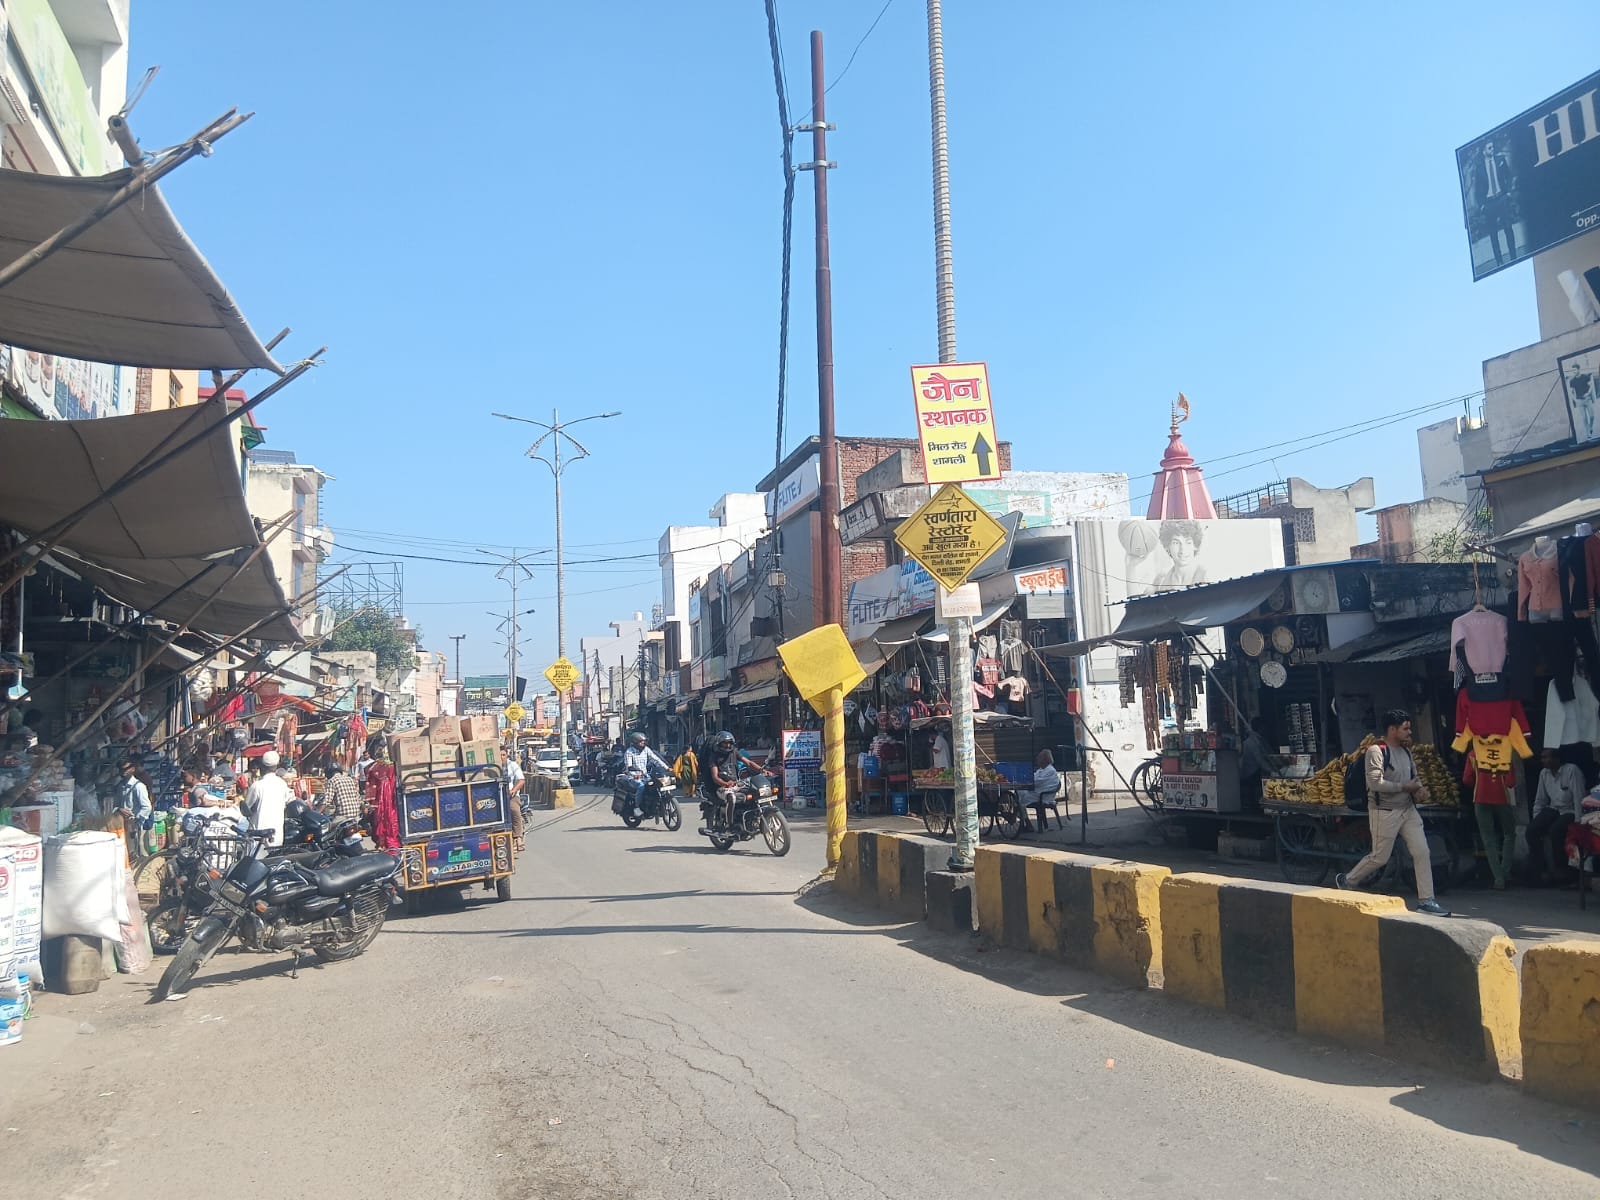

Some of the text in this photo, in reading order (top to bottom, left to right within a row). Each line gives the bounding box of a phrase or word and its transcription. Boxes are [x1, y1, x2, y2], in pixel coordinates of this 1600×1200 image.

[1576, 213, 1600, 228] Opp.
[921, 373, 981, 401] जैन
[922, 408, 987, 427] स्थानक
[928, 441, 967, 452] मिल रोड
[932, 454, 966, 465] शामली
[924, 509, 977, 525] स्वर्णतारा
[928, 524, 973, 536] रेस्टोरेंट
[936, 543, 951, 552] खुल
[1019, 572, 1047, 590] स्कूल
